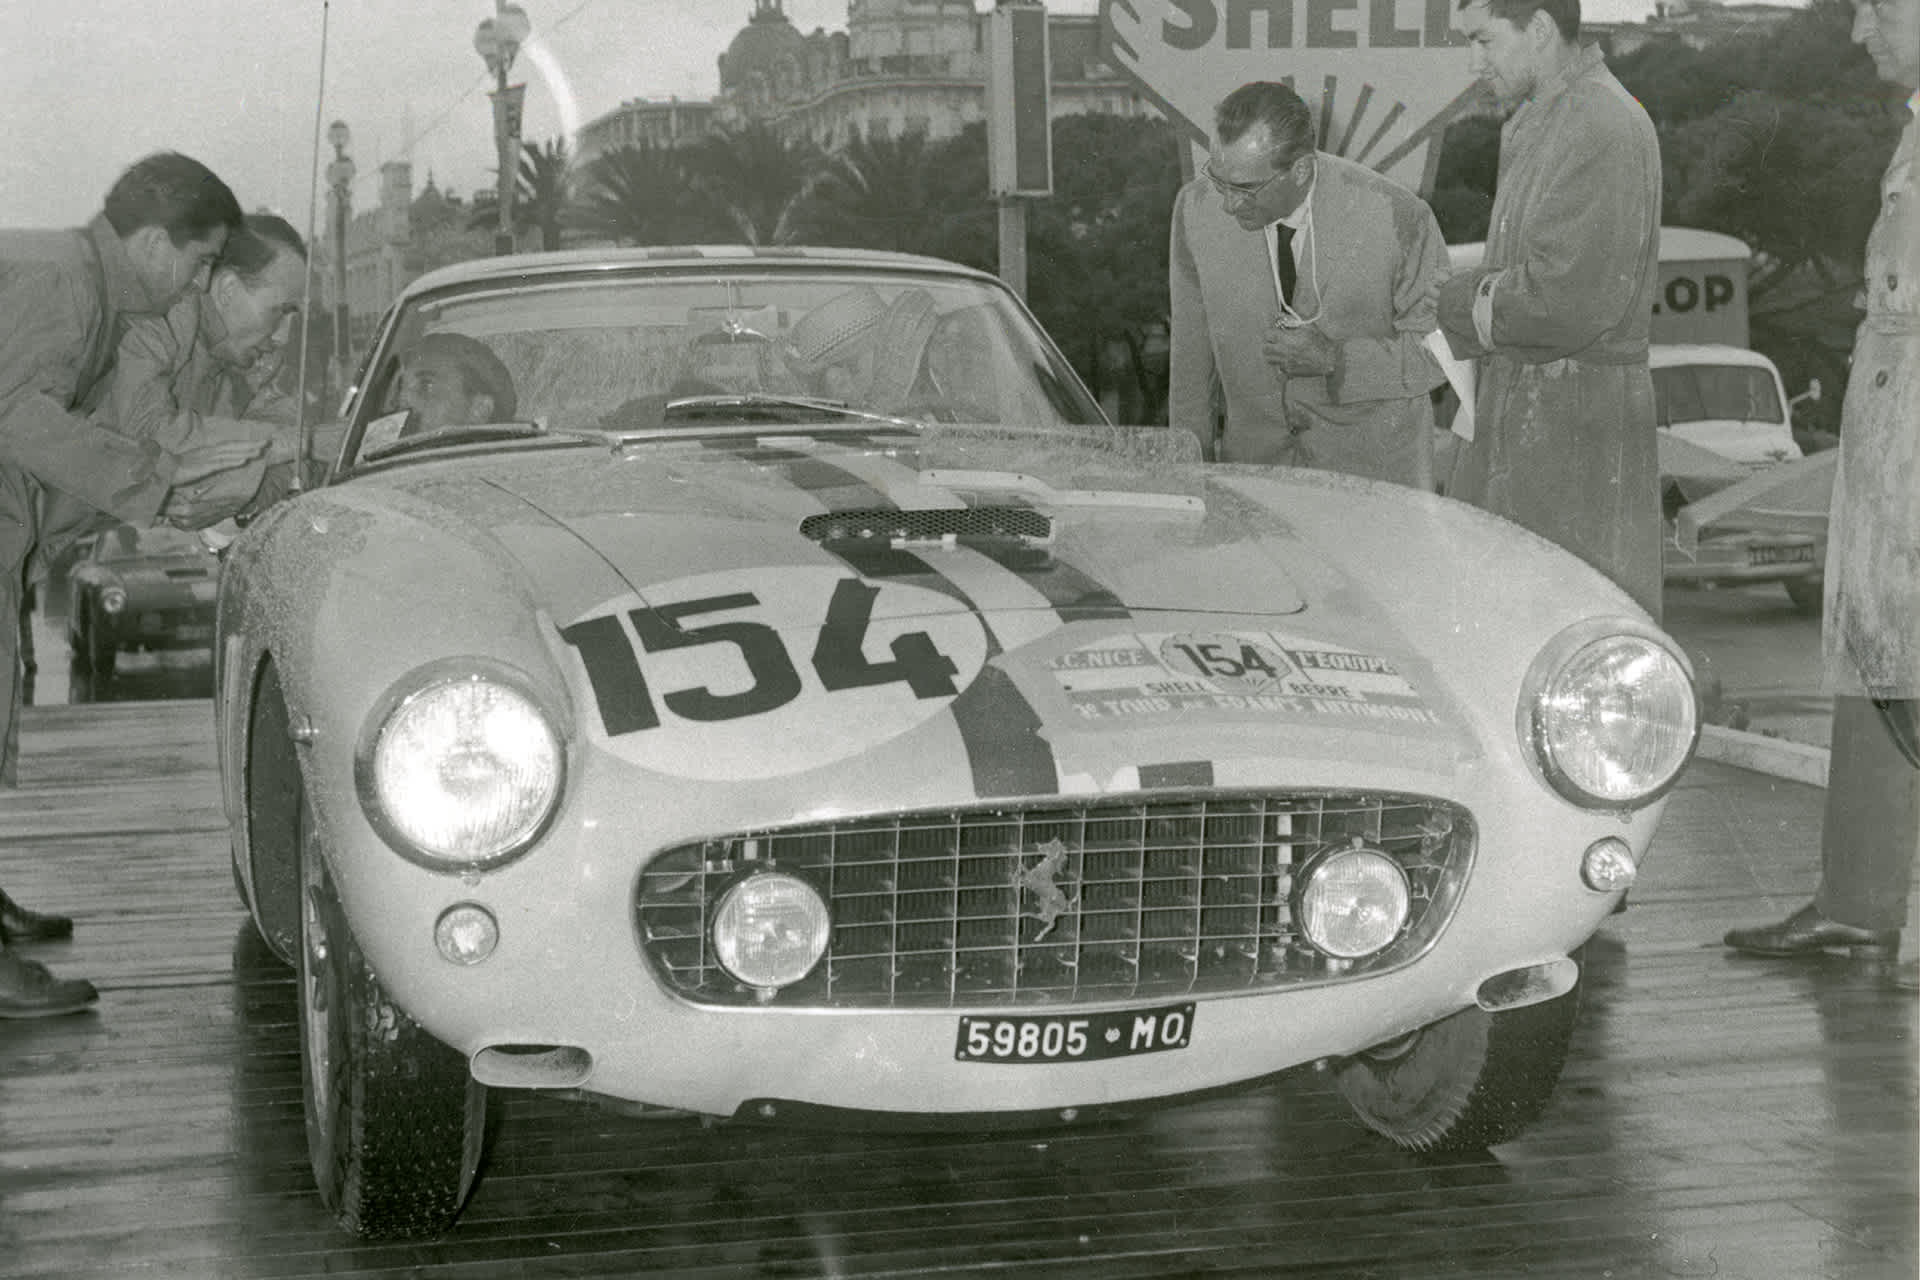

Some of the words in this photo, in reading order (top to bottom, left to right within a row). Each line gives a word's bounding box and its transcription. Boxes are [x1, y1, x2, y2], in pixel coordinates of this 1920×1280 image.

[1162, 0, 1473, 50] SHELL
[559, 578, 960, 736] 154
[1173, 644, 1278, 678] 154
[967, 1020, 1089, 1058] 59805
[1130, 1012, 1186, 1050] MO
